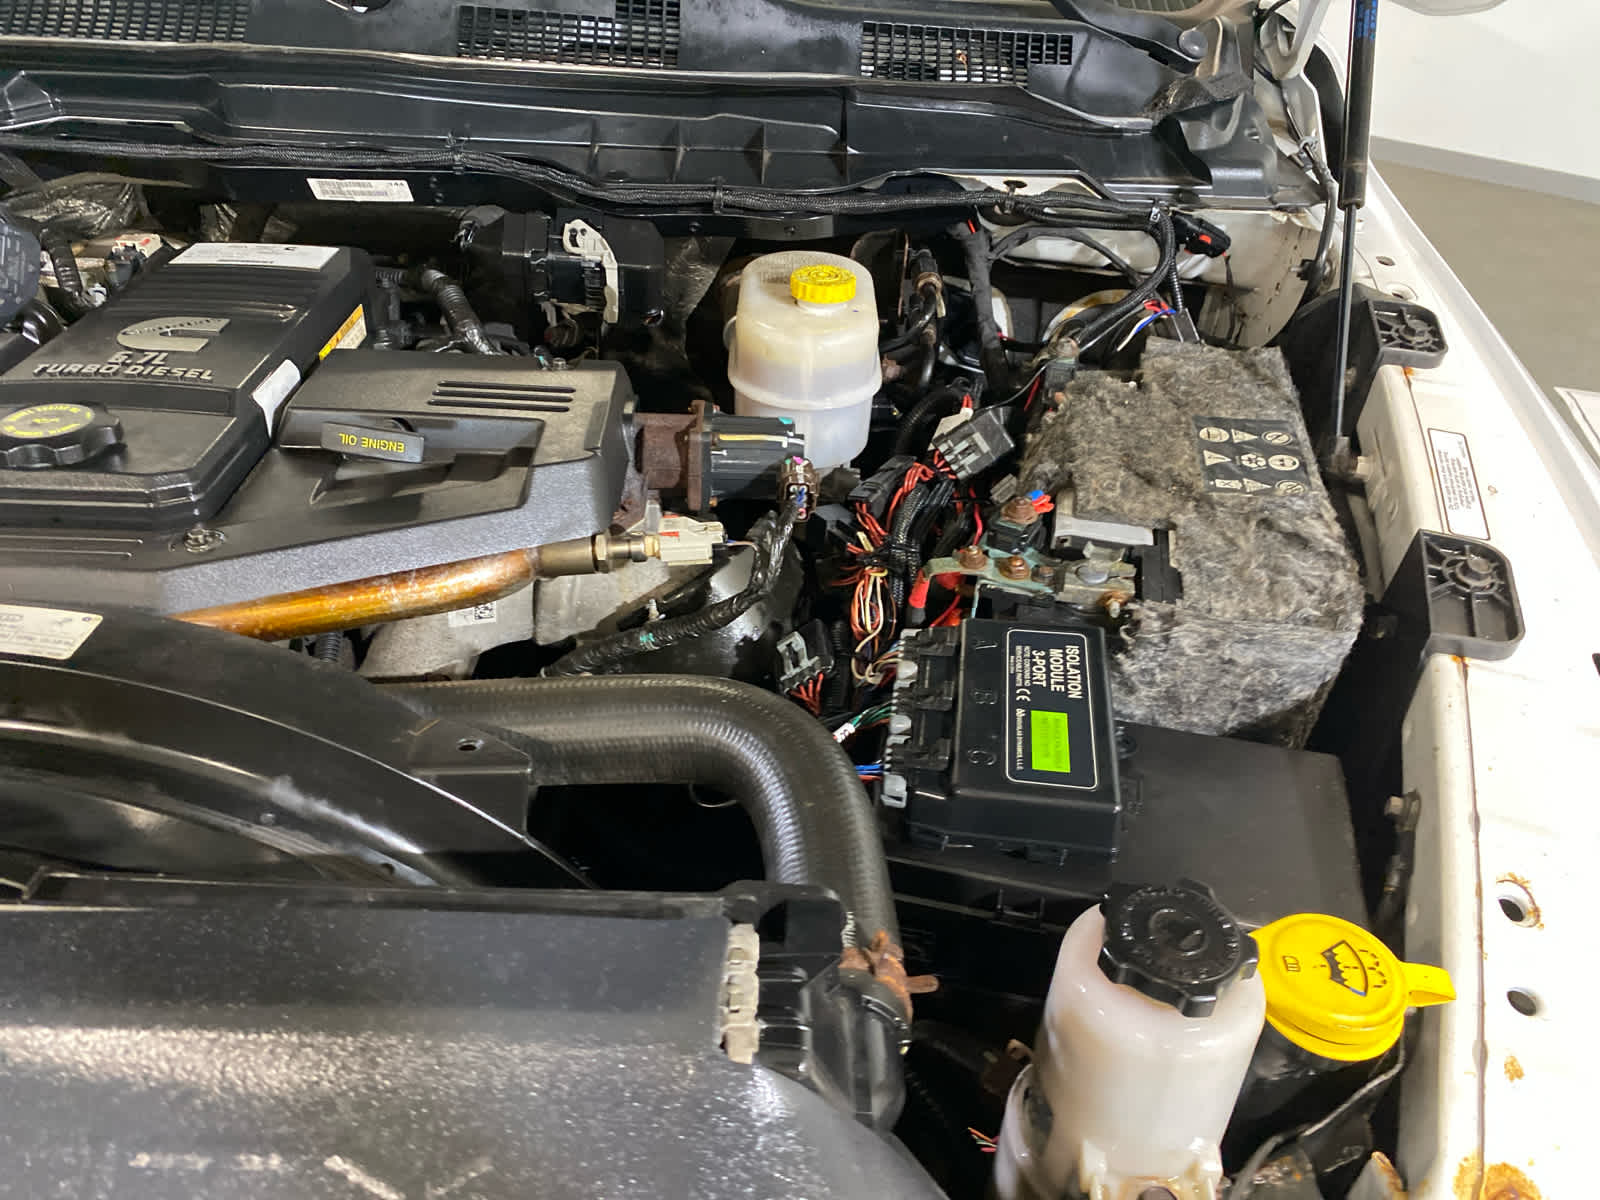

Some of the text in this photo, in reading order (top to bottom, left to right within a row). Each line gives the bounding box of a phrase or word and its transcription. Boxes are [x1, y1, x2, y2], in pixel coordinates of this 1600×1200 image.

[32, 363, 213, 381] TURBO DIESEL
[338, 432, 405, 453] ENGINE OIL
[1032, 650, 1047, 687] 3-PORT
[1049, 648, 1065, 692] MODULE
[1065, 645, 1083, 699] ISOLATION
